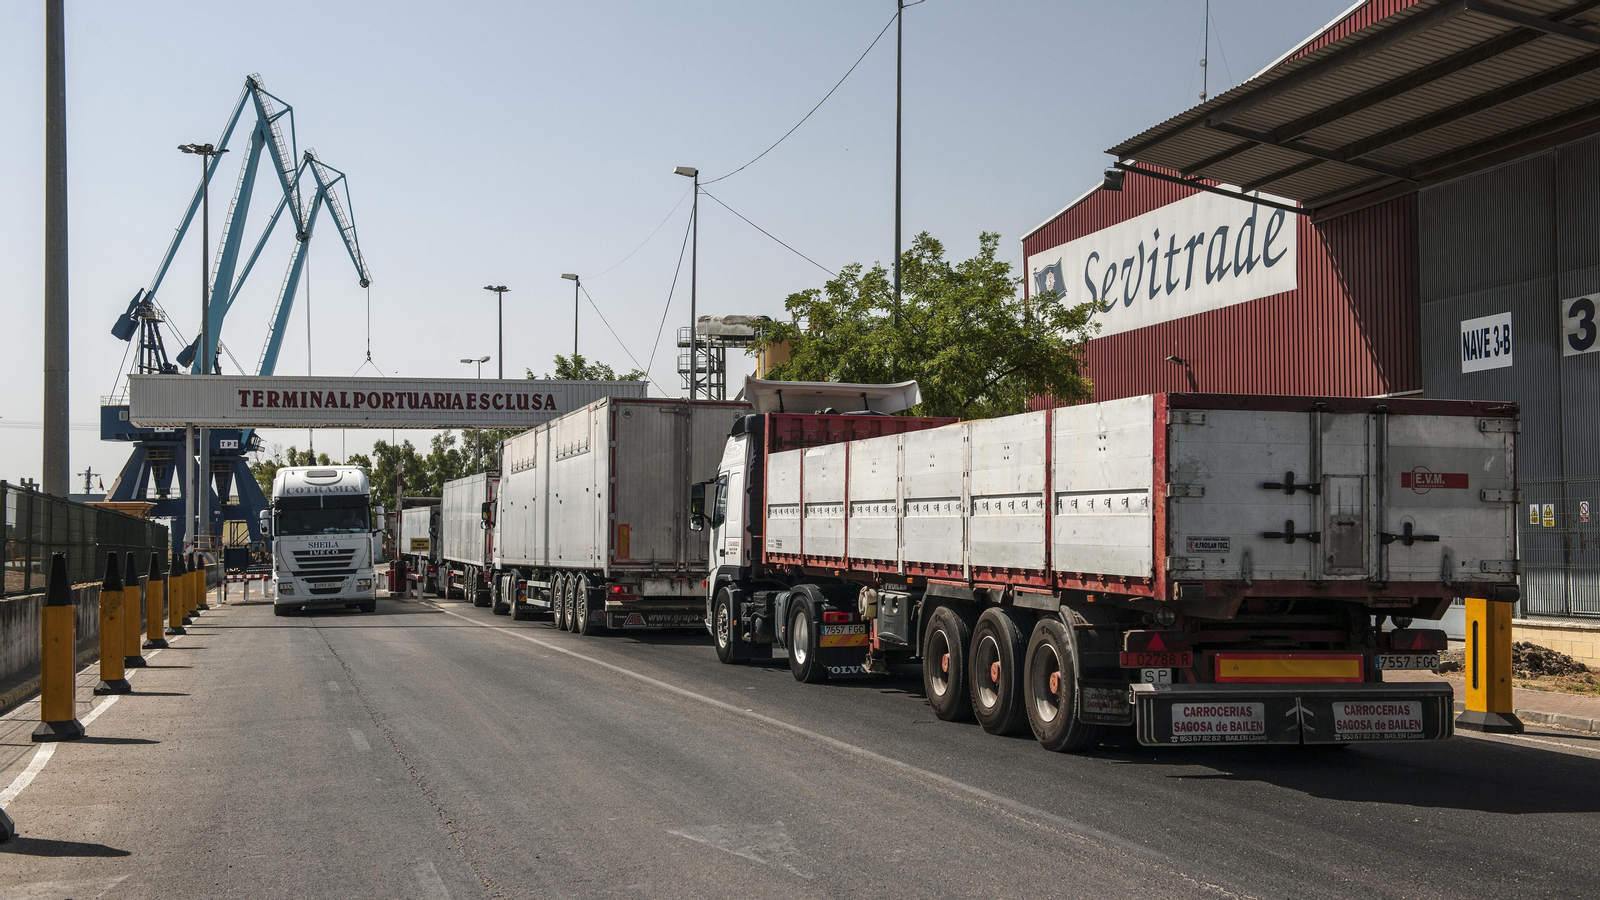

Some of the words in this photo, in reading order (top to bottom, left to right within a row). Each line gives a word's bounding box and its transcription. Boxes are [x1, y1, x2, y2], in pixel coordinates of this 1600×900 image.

[1084, 191, 1288, 324] Sevitrade
[1567, 298, 1597, 351] 3
[1463, 327, 1491, 361] NAVE
[1493, 324, 1511, 357] 3-B
[1415, 473, 1446, 485] E.V.M.
[286, 485, 359, 495] COTRAMIX
[308, 541, 339, 549] SHEILA
[826, 625, 845, 635] 7557
[848, 625, 864, 634] FGC
[1380, 656, 1411, 668] 7557
[1416, 656, 1437, 668] FGC
[1183, 706, 1253, 717] CARROCERIAS
[1344, 705, 1410, 716] CARROCERIAS
[1173, 721, 1213, 732] SAGOSA
[1215, 721, 1228, 732] de
[1229, 720, 1263, 732] BAILEN
[1336, 719, 1373, 730] SAGOSA
[1374, 719, 1386, 730] de
[1388, 719, 1421, 730] BAILEN
